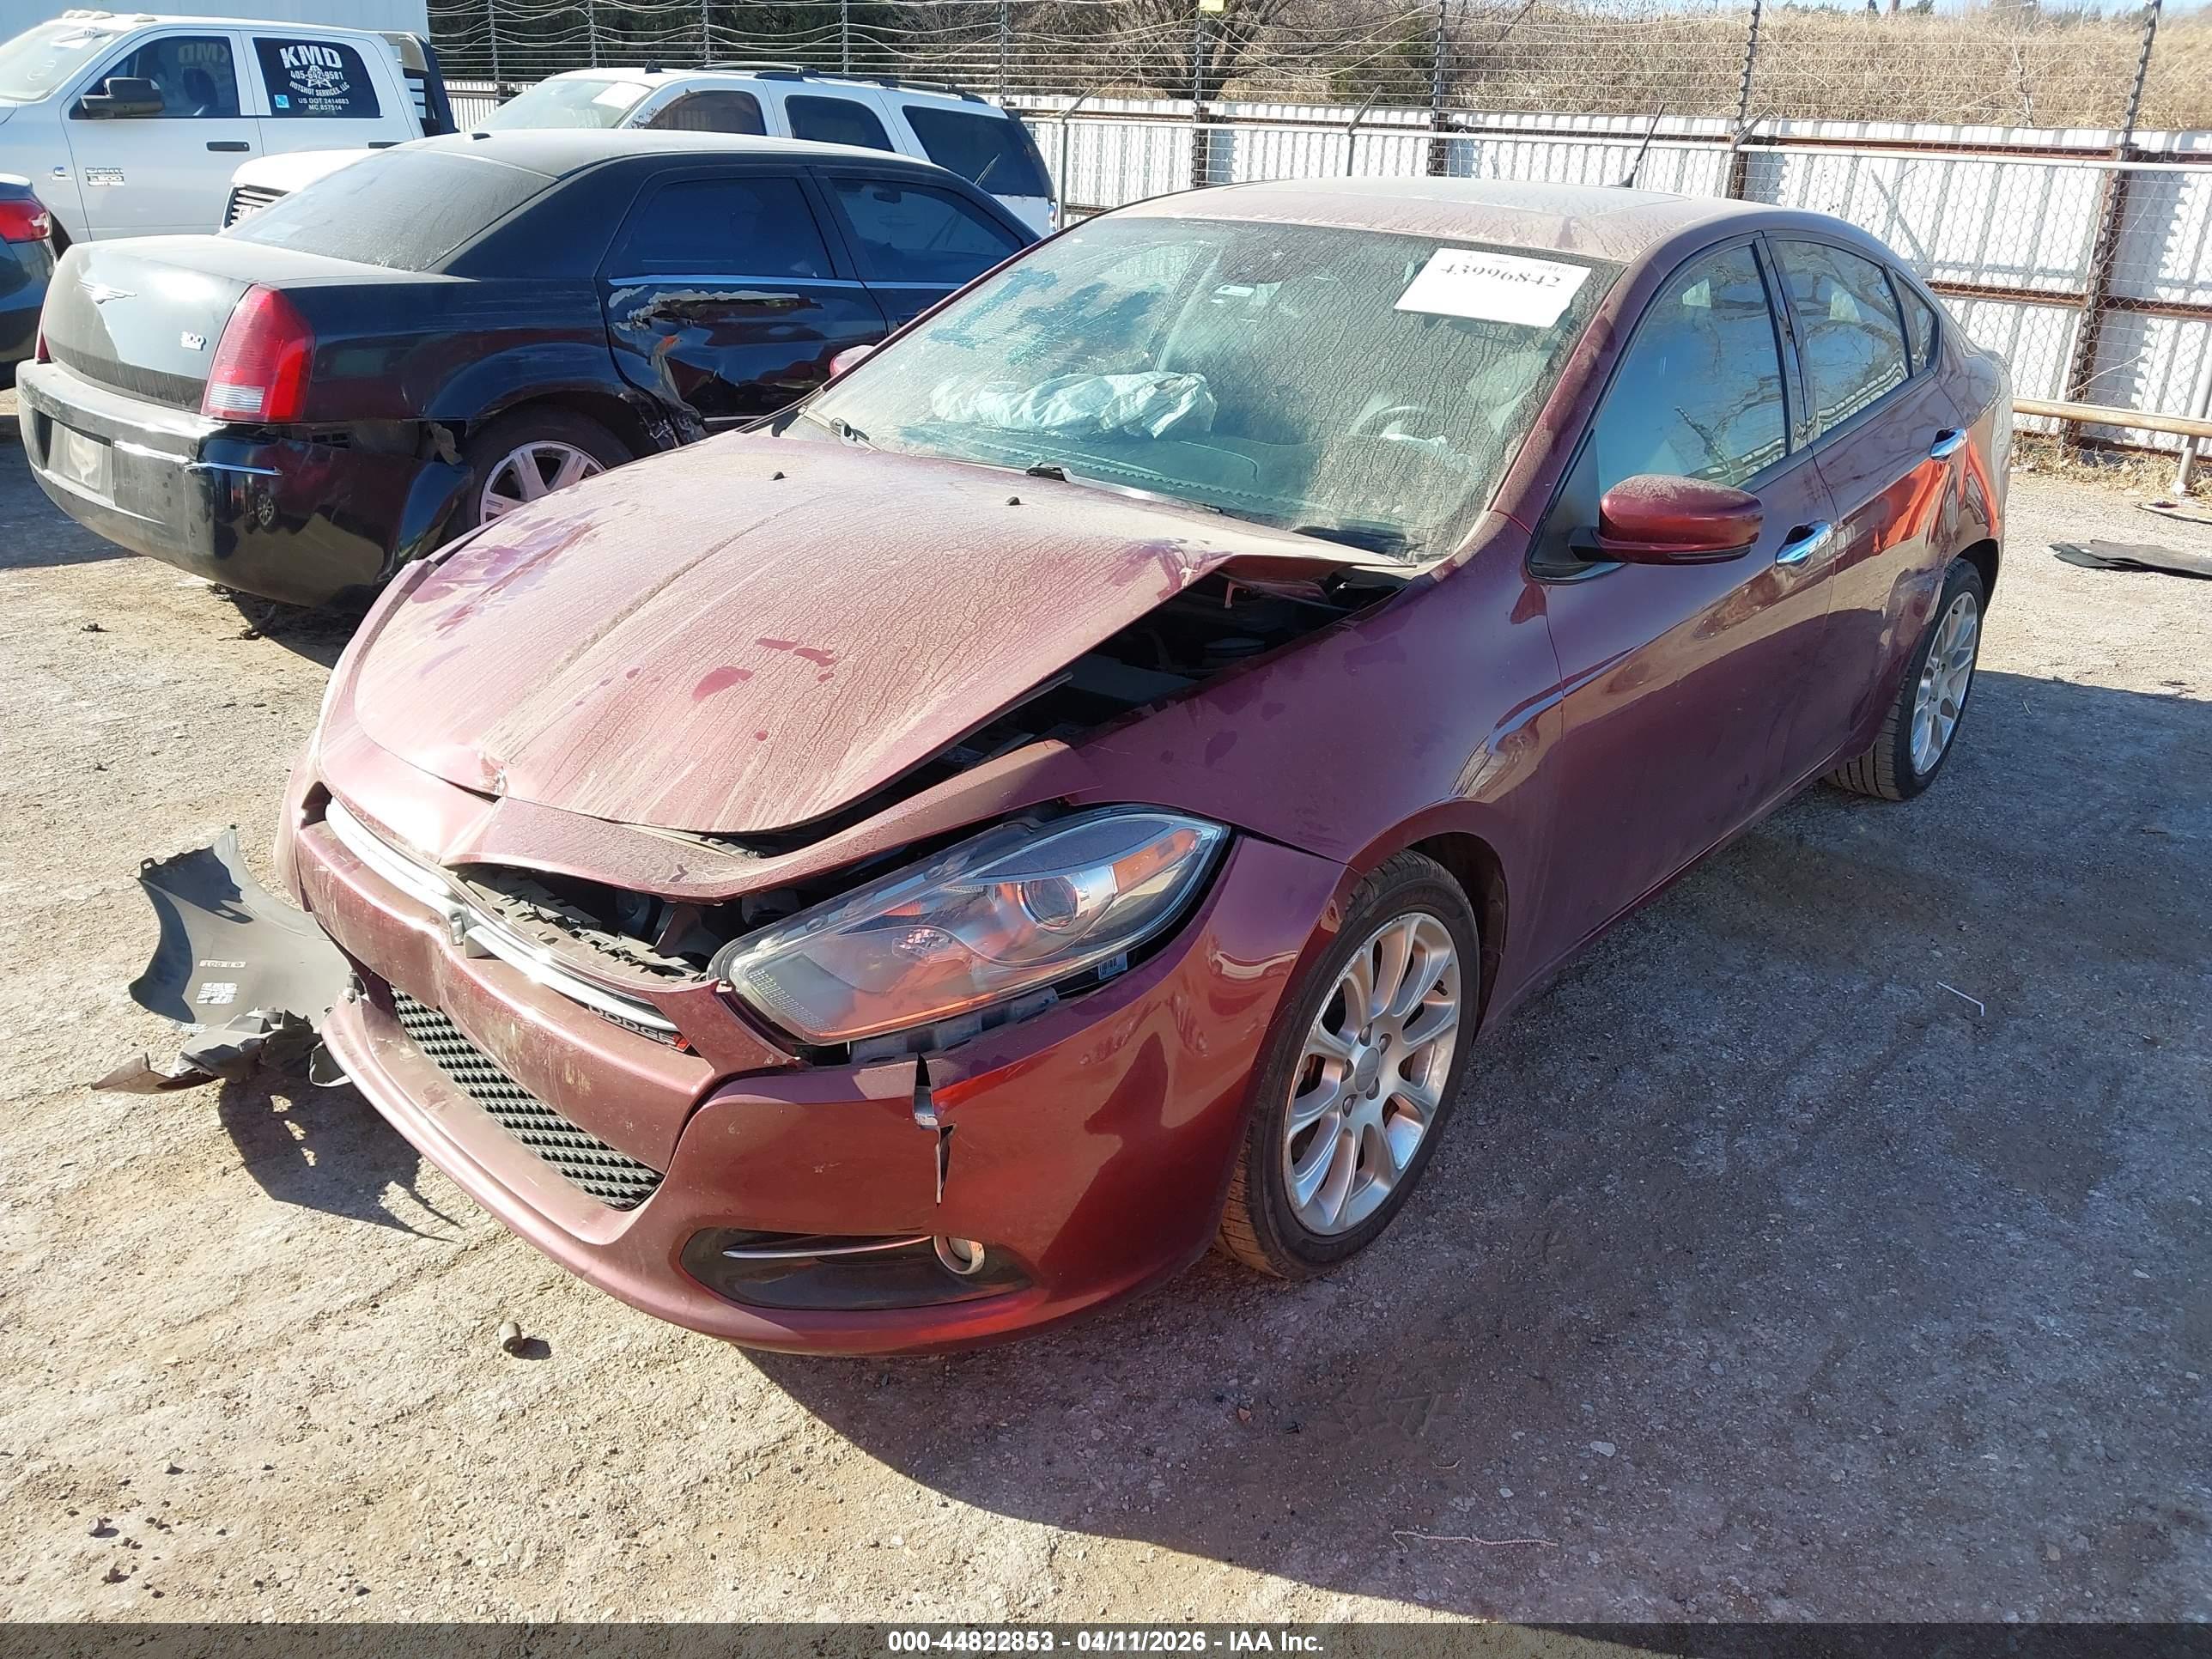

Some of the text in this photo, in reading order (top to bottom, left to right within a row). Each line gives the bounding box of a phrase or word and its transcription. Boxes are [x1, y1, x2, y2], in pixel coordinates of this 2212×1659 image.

[279, 45, 343, 69] KMD
[290, 70, 343, 80] 405-642-9581
[340, 82, 350, 91] LLC
[1440, 263, 1562, 289] 43996842
[588, 1004, 678, 1046] DODGE
